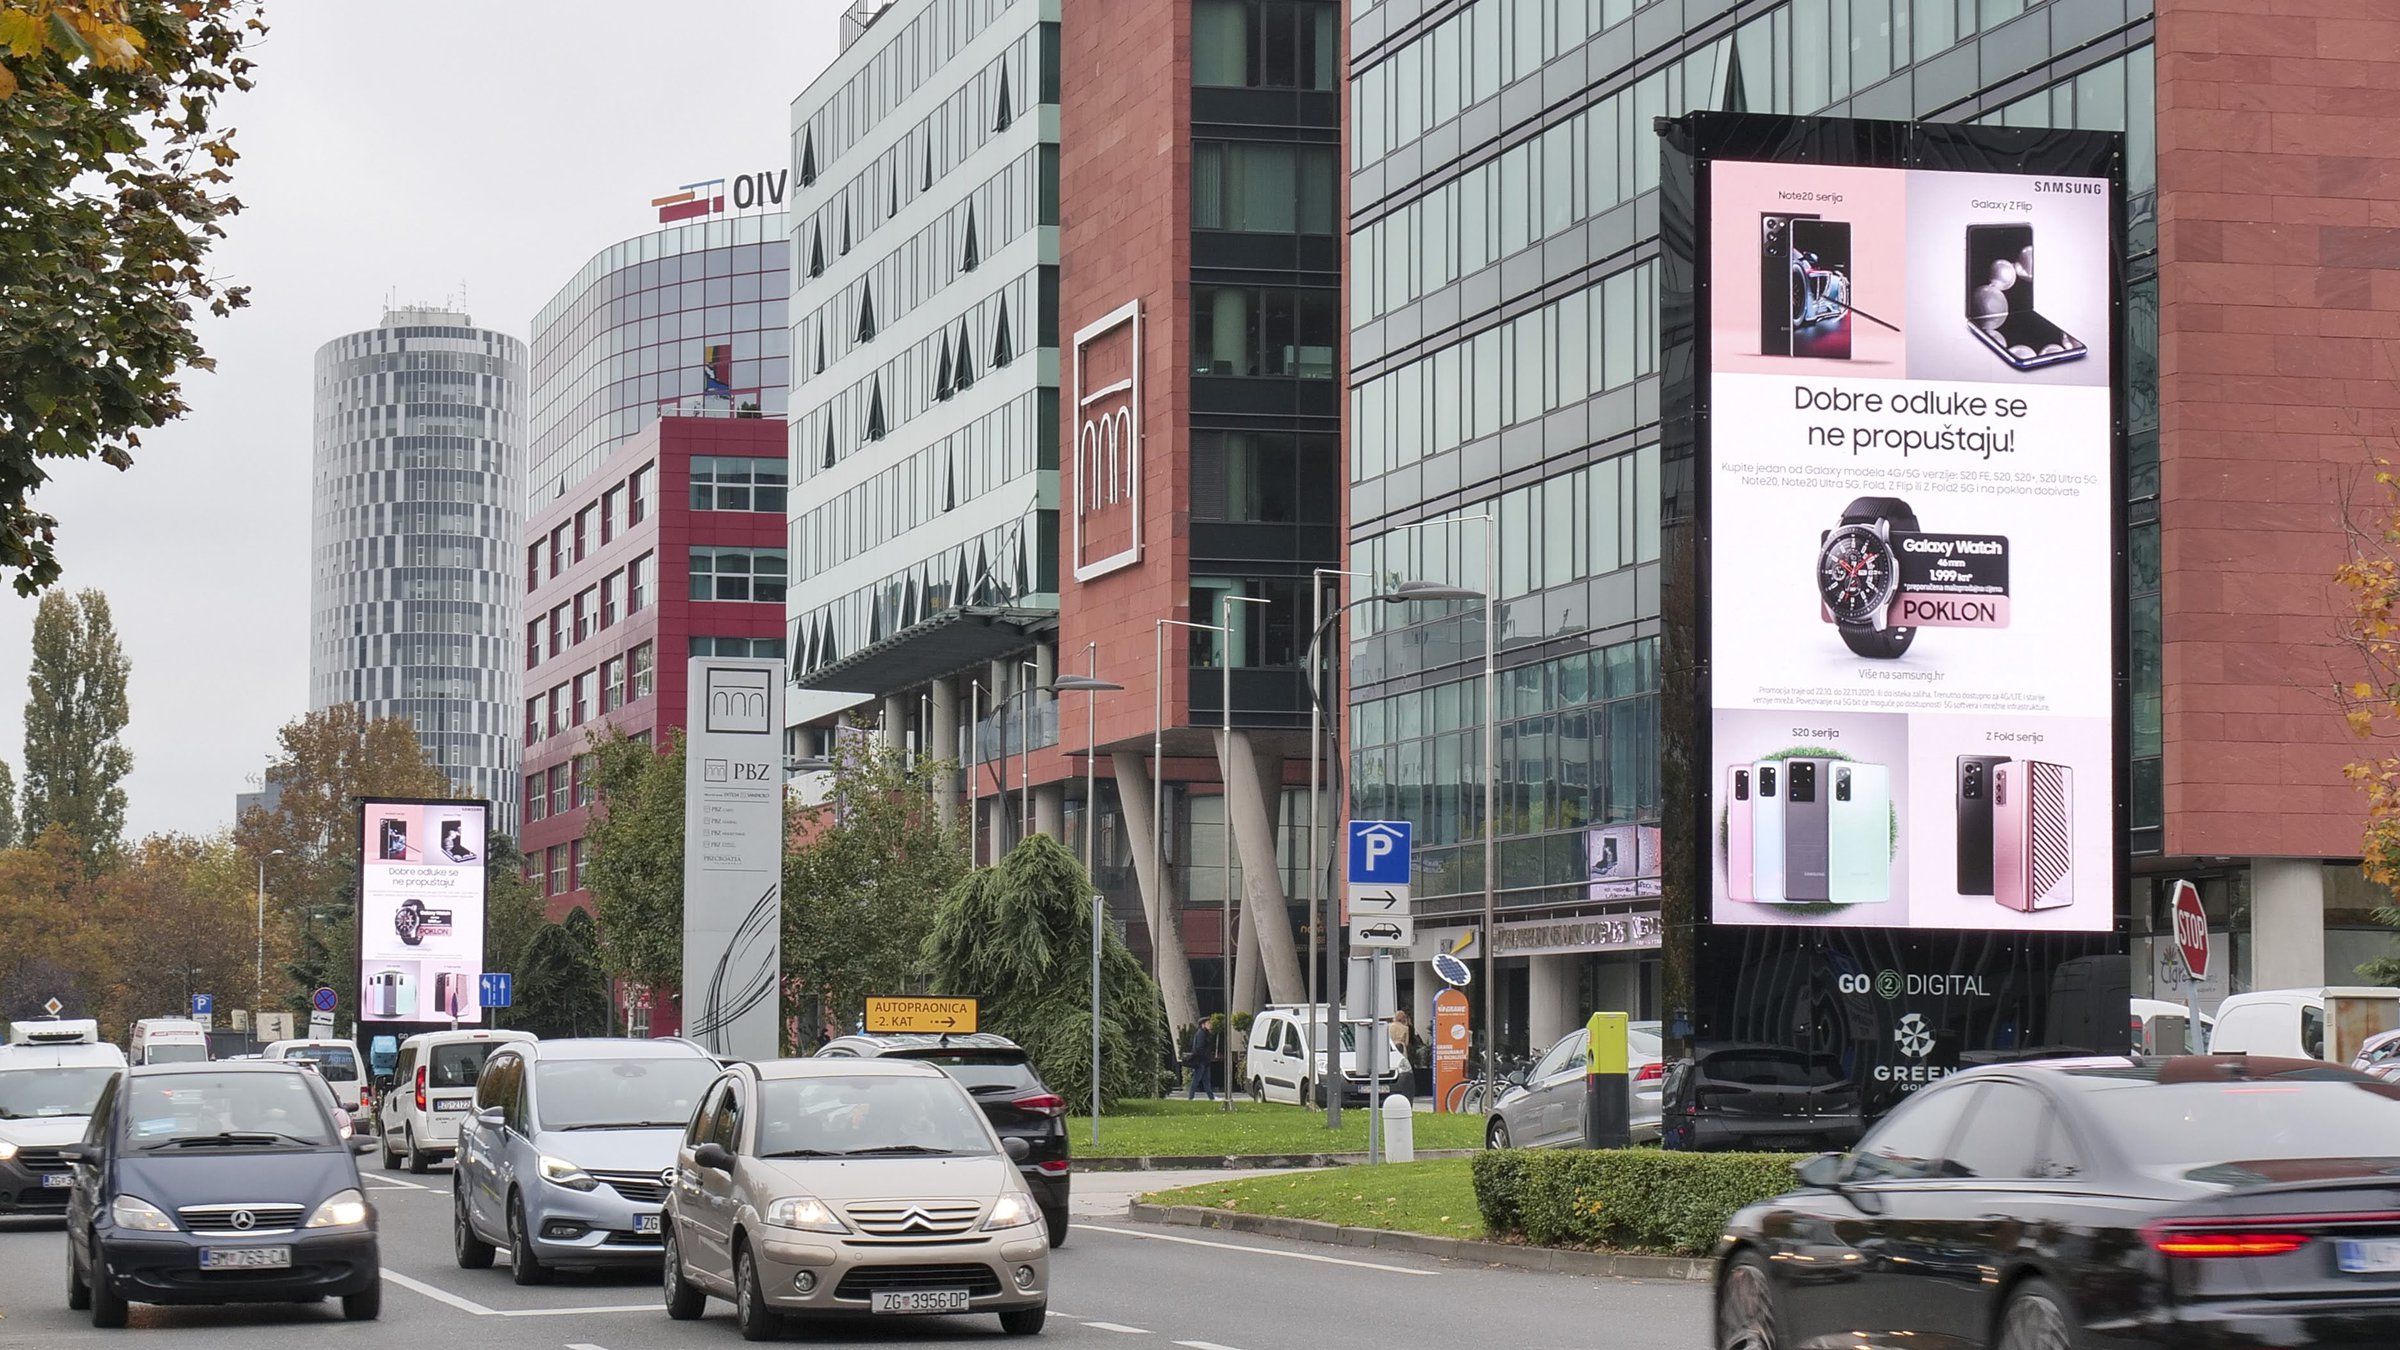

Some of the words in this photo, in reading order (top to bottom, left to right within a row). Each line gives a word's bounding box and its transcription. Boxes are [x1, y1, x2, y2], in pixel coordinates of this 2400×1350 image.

[733, 168, 788, 209] OIV
[2034, 180, 2102, 195] SAMSUNG
[1778, 190, 1814, 201] Note20
[1815, 191, 1844, 204] serija
[1971, 199, 2008, 212] Galaxy
[2009, 201, 2015, 210] Z
[2016, 201, 2033, 213] Flip
[1794, 385, 1884, 413] Dobre
[1891, 390, 1988, 417] odluke
[1994, 397, 2028, 418] se
[1808, 426, 1846, 447] ne
[1853, 423, 2015, 460] propuštaju!
[1721, 462, 1754, 474] Kupite
[1755, 463, 1787, 476] jedan
[1788, 464, 1803, 474] od
[1804, 465, 1842, 478] Galaxy
[1843, 466, 1886, 478] modela
[1886, 468, 1921, 479] 4G/5G
[1960, 471, 1978, 481] S20
[1781, 477, 1818, 488] Note20
[1819, 478, 1844, 489] Ultra
[1996, 484, 2032, 496] poklon
[2034, 485, 2080, 497] dobivate
[1903, 538, 1955, 557] Galaxy
[1955, 540, 2003, 555] Watch
[1929, 569, 1957, 581] 1.999
[1903, 600, 1996, 622] POKLON
[1858, 668, 1878, 679] Više
[1879, 671, 1891, 680] na
[1891, 670, 1945, 684] samsung.hr
[1792, 727, 1810, 738] S20
[1811, 728, 1840, 741] serija
[1986, 731, 1992, 741] Z
[1993, 731, 2015, 742] Fold
[2016, 732, 2044, 745] serija
[734, 763, 770, 781] PBZ
[1365, 833, 1393, 872] P
[388, 867, 416, 876] Dobre
[417, 868, 447, 877] odluke
[420, 927, 449, 935] POKLON
[2178, 908, 2205, 951] STOP
[1838, 973, 1871, 994] GO
[1906, 974, 1991, 996] DIGITAL
[875, 1002, 968, 1013] AUTOPRAONICA
[875, 1016, 889, 1026] -2.
[891, 1016, 914, 1026] KAT
[643, 1217, 658, 1230] ZG
[883, 1294, 901, 1309] ZG
[911, 1292, 968, 1309] 3956-DP
